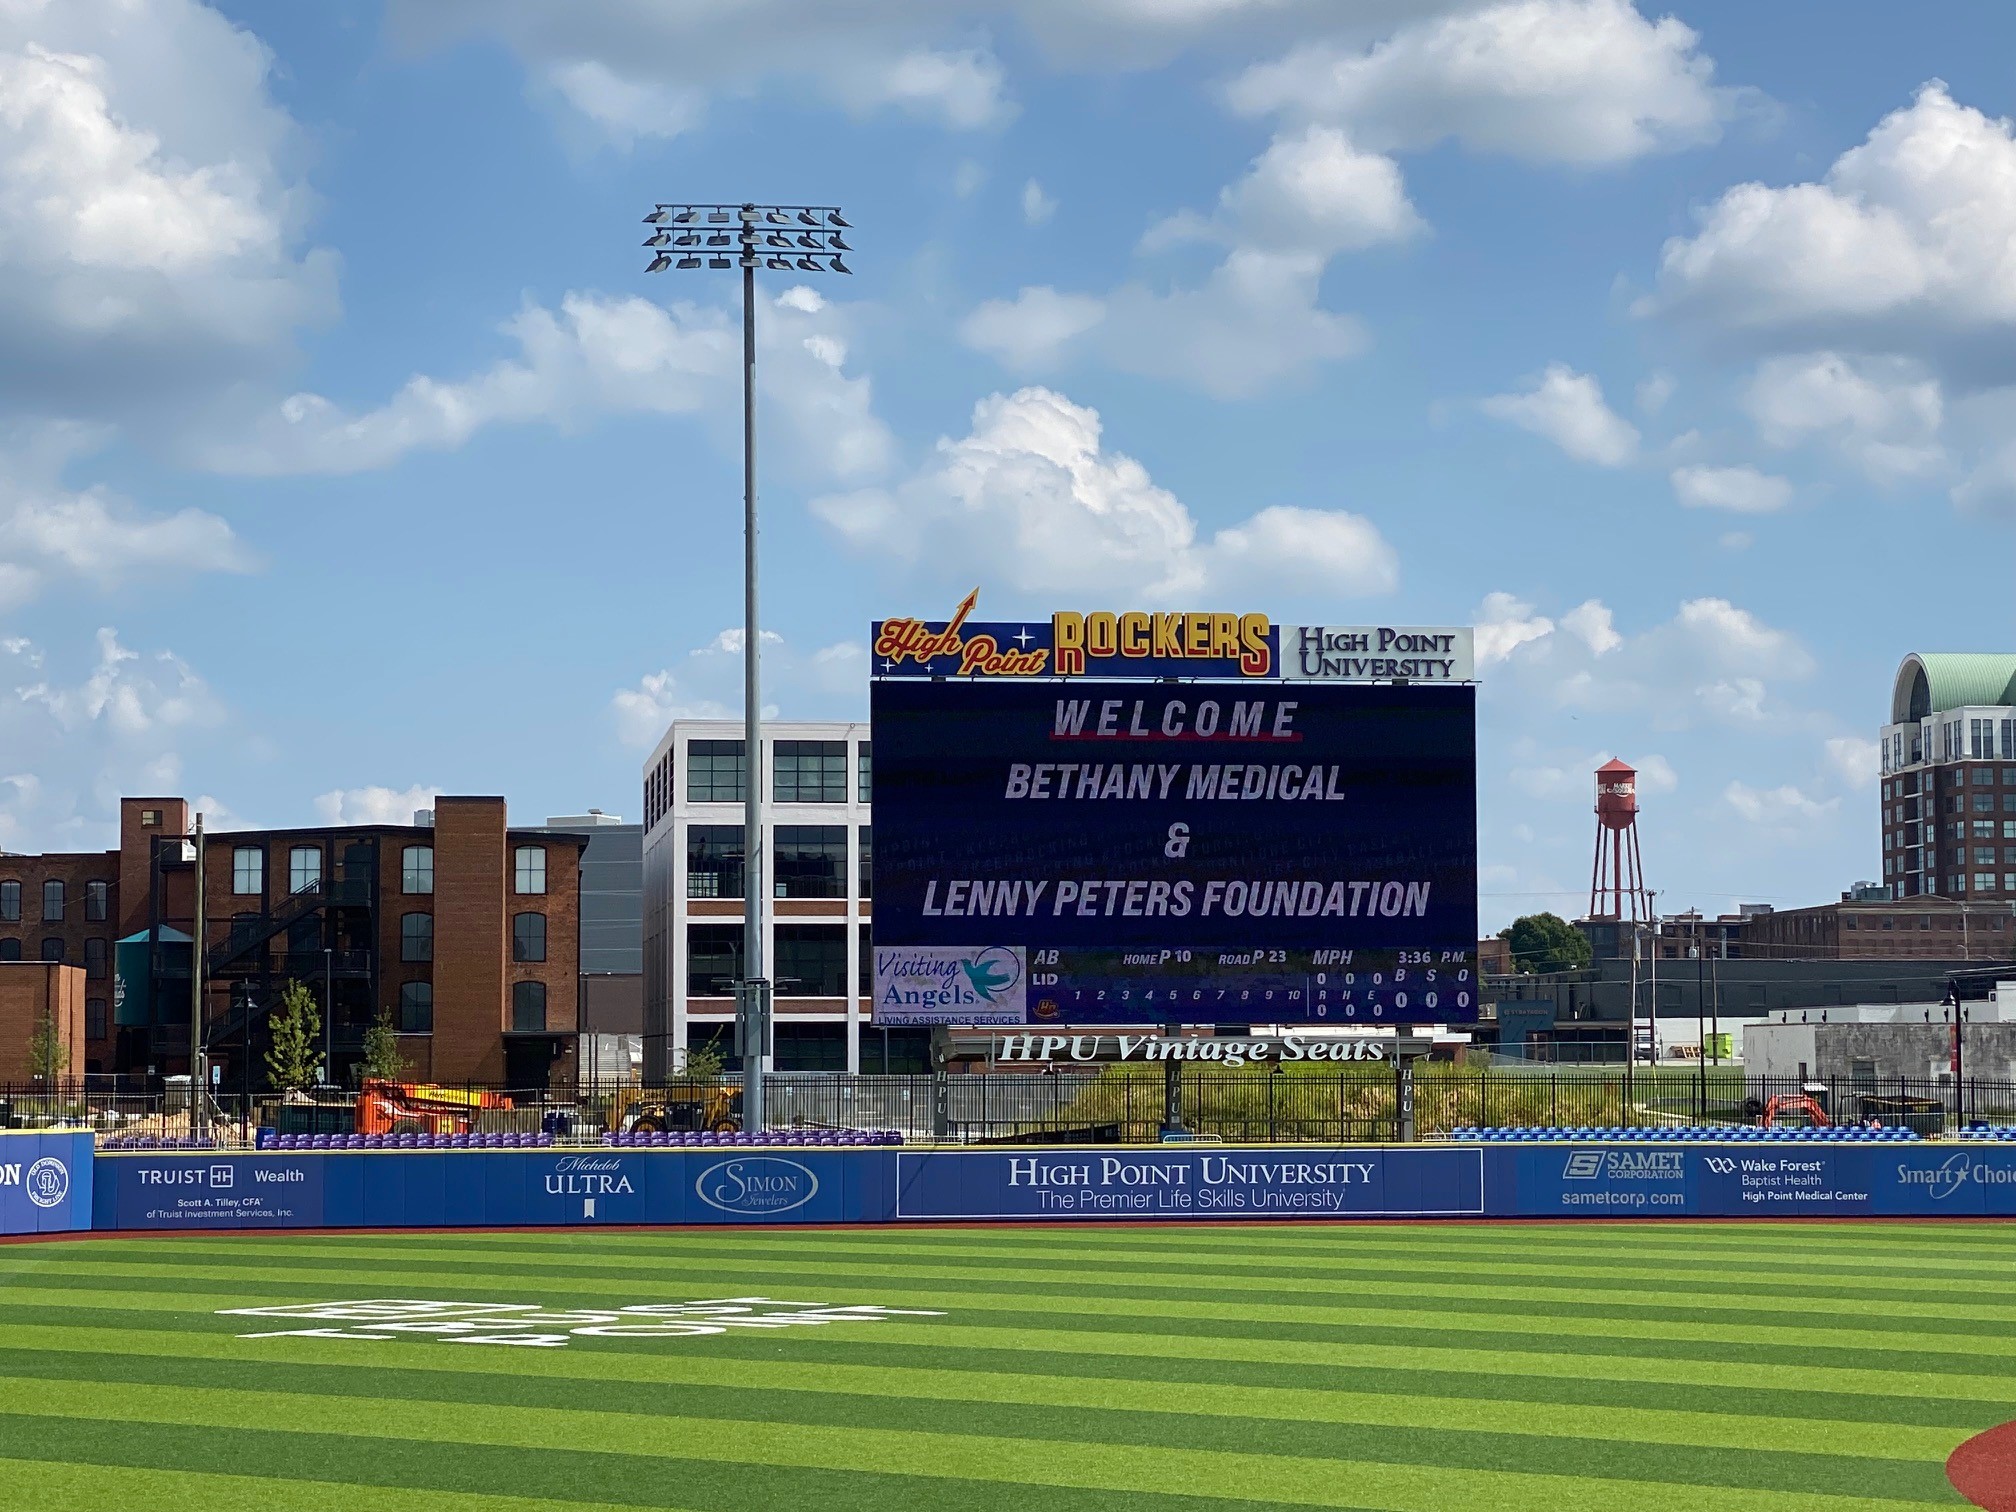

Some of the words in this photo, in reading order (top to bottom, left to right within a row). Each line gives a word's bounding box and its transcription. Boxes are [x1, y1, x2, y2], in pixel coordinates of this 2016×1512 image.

[875, 600, 972, 664] High
[957, 634, 1049, 675] Point
[1053, 611, 1270, 676] ROCKERS
[1299, 627, 1369, 652] HIGH
[1378, 627, 1456, 652] POINT
[1299, 651, 1455, 677] UNIVERSITY
[1054, 700, 1298, 738] WELCOME
[1005, 764, 1181, 800] BETHANY
[1187, 764, 1345, 800] MEDICAL
[1164, 822, 1190, 859] &
[923, 881, 1051, 917] LENNY
[1053, 881, 1194, 917] PETERS
[1201, 881, 1430, 917] FOUNDATION
[1033, 950, 1060, 965] AB
[1123, 954, 1158, 965] HOME
[1159, 950, 1171, 965] P
[1175, 950, 1191, 963] 10
[1218, 954, 1250, 965] ROAD
[1252, 950, 1265, 965] P
[1268, 950, 1287, 963] 23
[1312, 950, 1353, 965] MPH
[1398, 951, 1431, 964] 3:36
[1441, 951, 1467, 964] P.M.
[878, 952, 961, 989] Visiting
[1395, 968, 1406, 982] B
[1426, 968, 1437, 982] S
[1033, 973, 1058, 986] LID
[1317, 972, 1326, 985] 0
[1345, 972, 1355, 985] 0
[1373, 972, 1383, 985] 0
[1097, 990, 1105, 1000] 2
[1122, 990, 1129, 1000] 3
[1145, 990, 1153, 1000] 4
[1170, 990, 1177, 1000] 5
[1193, 990, 1201, 1000] 6
[1217, 990, 1225, 1000] 7
[1241, 990, 1249, 1000] 8
[1265, 990, 1273, 1000] 9
[1288, 990, 1300, 1000] 10
[1318, 990, 1327, 1000] R
[1342, 990, 1351, 1000] H
[1368, 990, 1375, 1000] E
[1395, 992, 1407, 1008] 0
[1425, 992, 1438, 1008] 0
[1457, 992, 1470, 1008] 0
[1317, 1004, 1327, 1017] 0
[1345, 1004, 1355, 1017] 0
[1373, 1004, 1383, 1017] 0
[878, 1015, 911, 1025] LIVING
[912, 1015, 972, 1025] ASSISTANCE
[974, 1015, 1020, 1025] SERVICES
[998, 1036, 1104, 1062] HPU
[1117, 1035, 1269, 1067] Vintage
[1280, 1035, 1384, 1062] Seats
[555, 1155, 621, 1172] Michelob
[1607, 1152, 1684, 1170] SAMET
[1741, 1160, 1776, 1172] Wake
[1780, 1160, 1822, 1172] Forest
[0, 1163, 21, 1186] N
[138, 1169, 206, 1185] TRUIST
[254, 1169, 304, 1184] Wealth
[1008, 1158, 1091, 1187] HIGH
[1100, 1158, 1190, 1186] POINT
[1201, 1157, 1375, 1186] UNIVERSITY
[1607, 1169, 1684, 1180] CORPORATION
[1897, 1164, 1952, 1184] Smart
[545, 1174, 635, 1195] ULTRA
[715, 1163, 798, 1204] SIMON
[1742, 1174, 1782, 1187] Baptist
[1785, 1174, 1822, 1187] Health
[177, 1198, 202, 1208] Scott
[204, 1198, 213, 1208] A.
[215, 1198, 241, 1209] Tilley,
[742, 1194, 789, 1208] Jewelers
[1037, 1189, 1075, 1209] The
[1080, 1189, 1152, 1209] Premier
[1158, 1188, 1191, 1208] Life
[1198, 1188, 1246, 1208] Skills
[1252, 1188, 1343, 1211] University
[1562, 1193, 1684, 1208] sametcorp.com
[1742, 1191, 1764, 1203] High
[1767, 1191, 1792, 1202] Point
[1794, 1191, 1832, 1202] Medical
[1835, 1191, 1868, 1202] Center
[146, 1208, 156, 1218] of
[157, 1208, 183, 1218] Truist
[184, 1208, 234, 1219] Investment
[235, 1208, 275, 1220] Services,
[277, 1208, 294, 1219] Inc.
